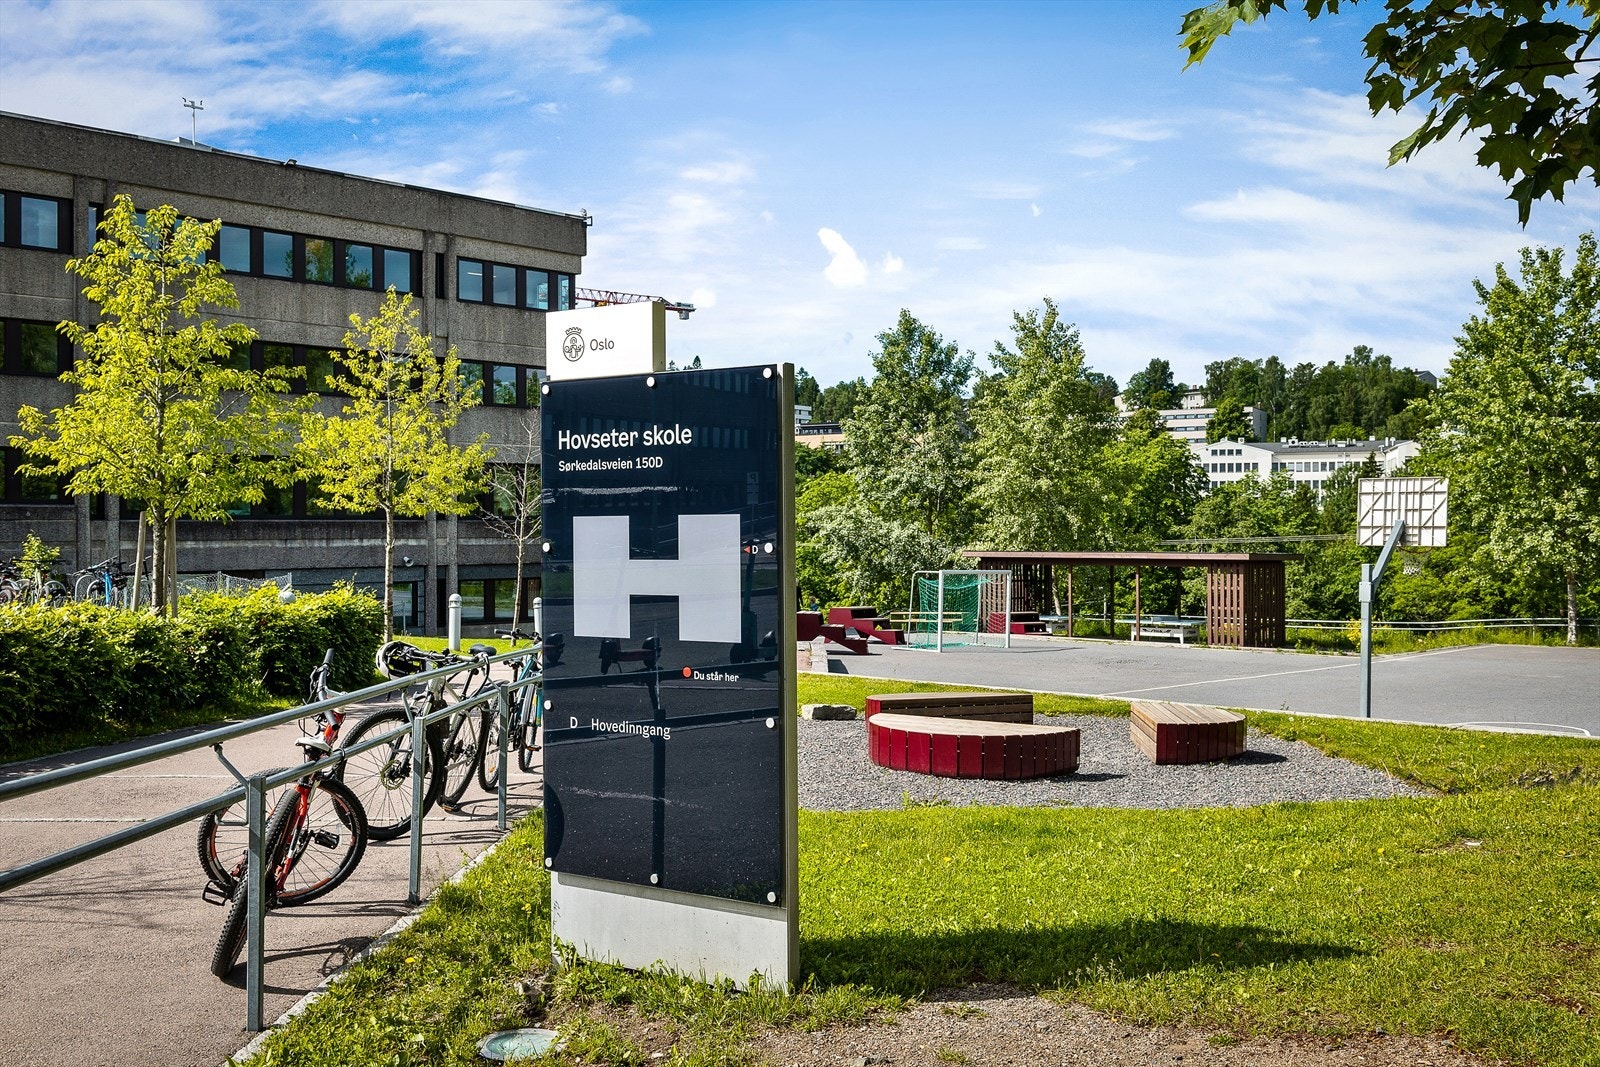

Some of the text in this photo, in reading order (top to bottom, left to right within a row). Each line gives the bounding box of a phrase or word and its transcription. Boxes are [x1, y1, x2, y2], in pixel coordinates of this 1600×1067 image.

[589, 338, 615, 352] Oslo
[558, 423, 693, 450] Hovseter skole
[558, 456, 663, 472] Sørkedalsveien 150D
[751, 545, 759, 555] D
[693, 670, 740, 683] Du står her
[569, 716, 671, 740] D Hovedinngang
